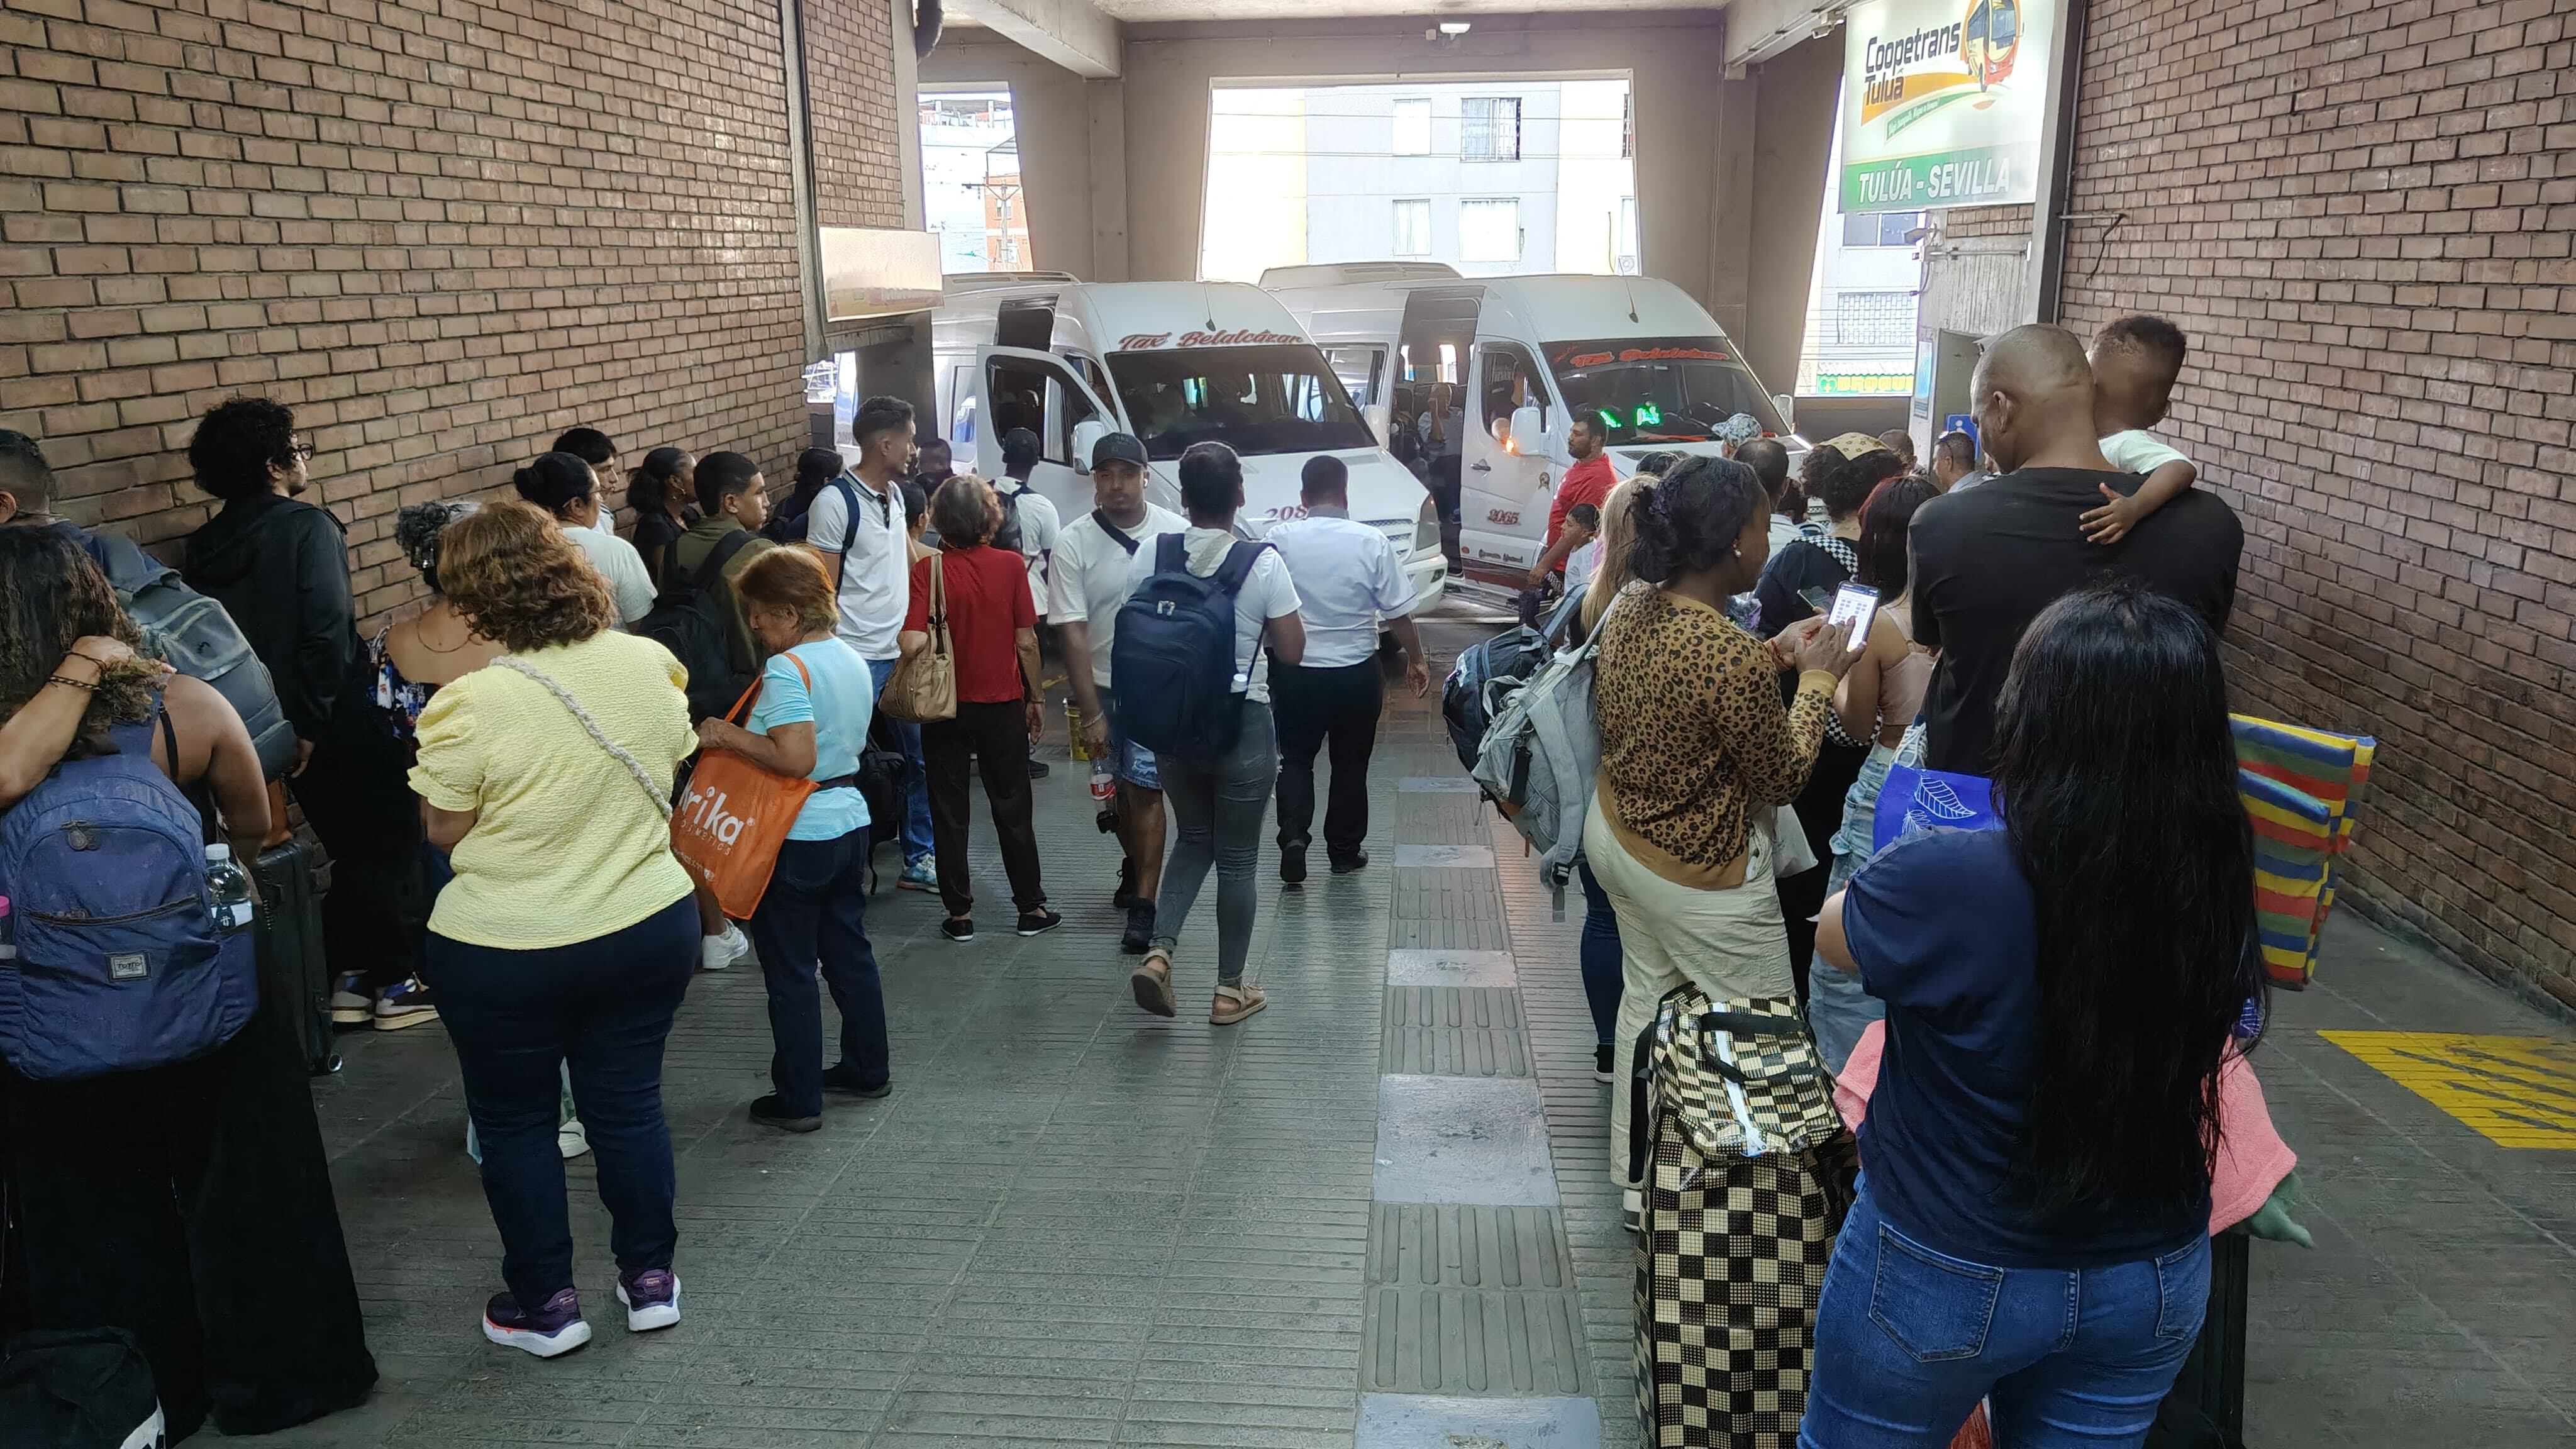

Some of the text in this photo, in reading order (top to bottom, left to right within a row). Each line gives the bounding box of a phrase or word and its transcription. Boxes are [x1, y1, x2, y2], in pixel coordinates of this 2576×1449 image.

[1865, 21, 1962, 77] Coopetrans
[1859, 160, 1913, 204] TULÚA
[1927, 157, 2011, 199] SEVILLA
